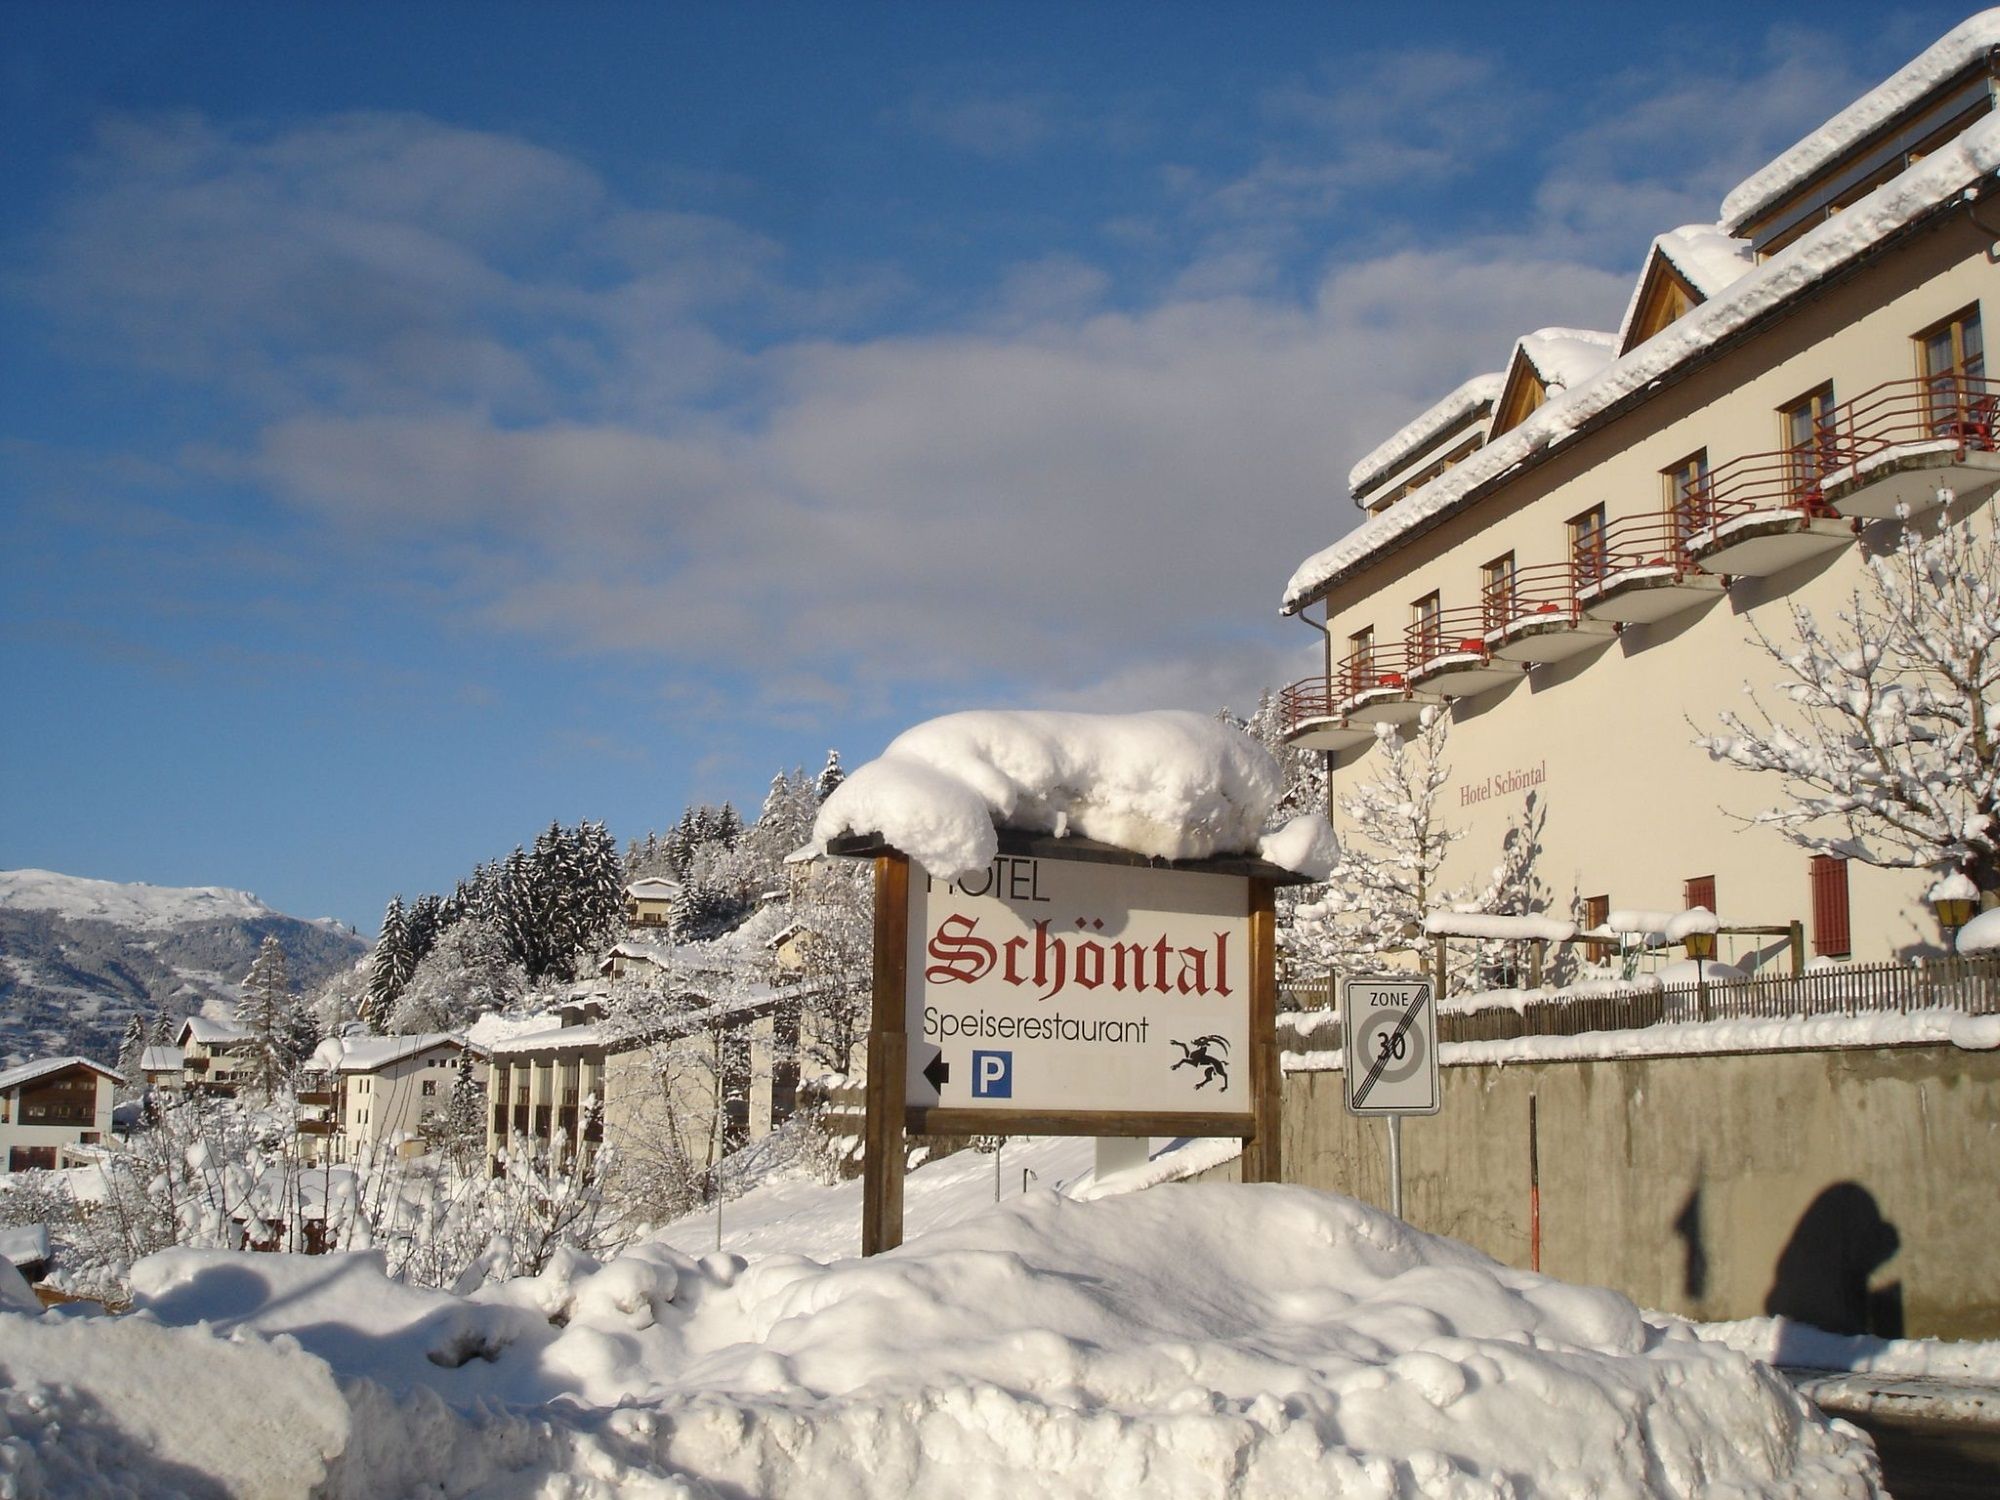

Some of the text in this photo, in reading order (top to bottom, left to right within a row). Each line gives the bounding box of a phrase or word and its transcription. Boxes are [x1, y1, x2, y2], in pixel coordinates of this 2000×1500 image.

[1460, 760, 1546, 807] Hotel Schöntal
[925, 913, 1233, 1001] Schöntal
[1370, 992, 1409, 1006] ZONE
[924, 1006, 1149, 1043] Speiserestaurant
[1377, 1032, 1405, 1060] 30
[980, 1056, 1005, 1094] P
